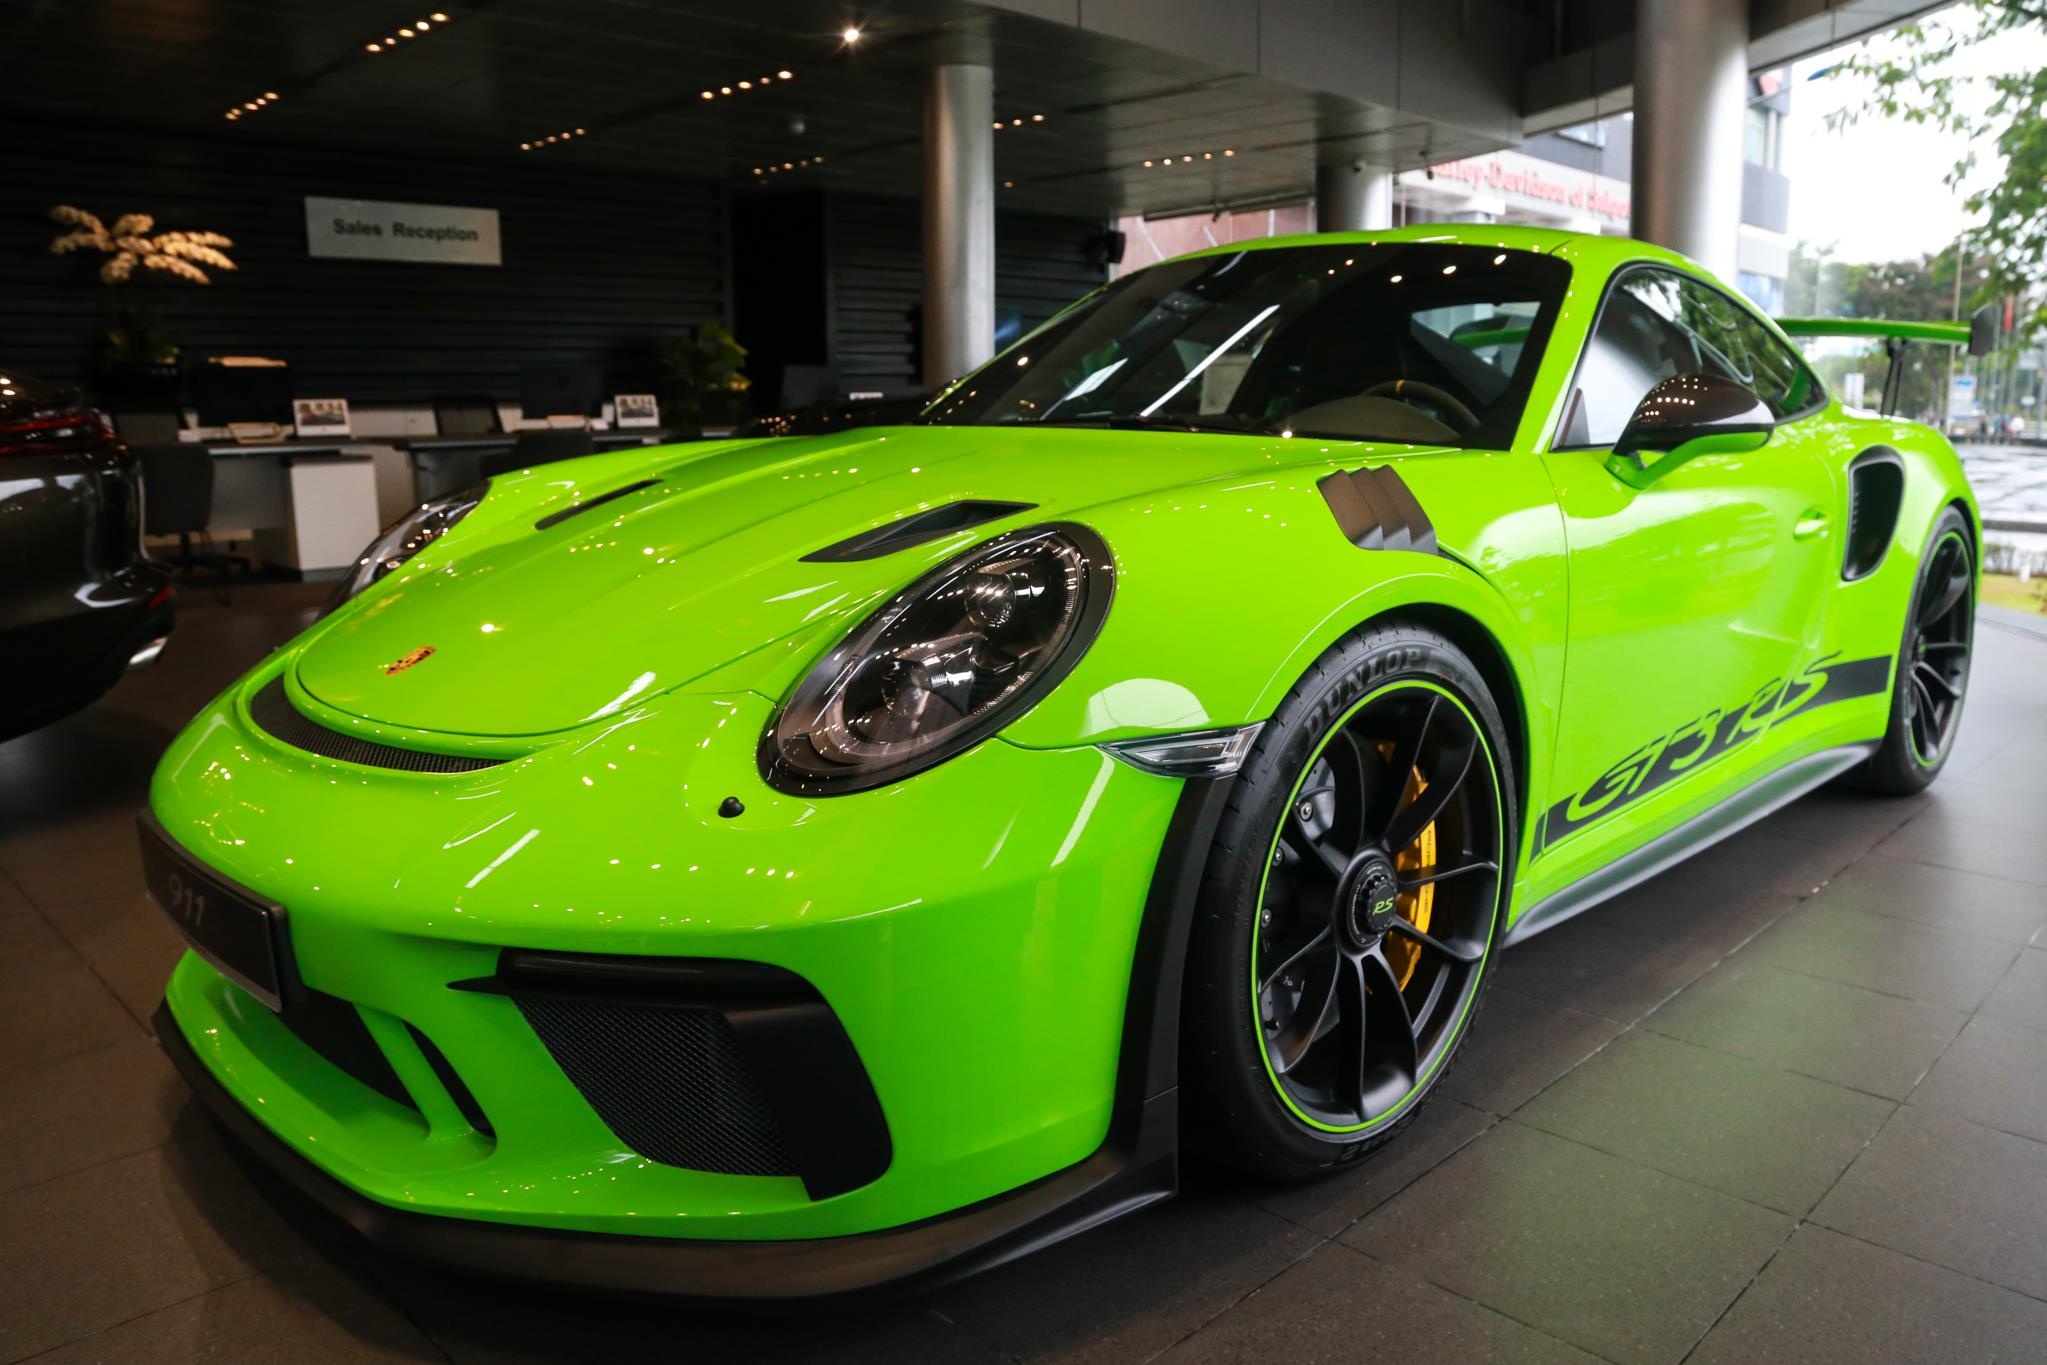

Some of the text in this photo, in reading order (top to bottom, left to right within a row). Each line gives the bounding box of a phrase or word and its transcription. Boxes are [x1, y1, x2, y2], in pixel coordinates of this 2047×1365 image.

[333, 218, 479, 242] Sales Reception
[1304, 648, 1421, 738] DUNLOP
[1566, 651, 1843, 822] GT3 RS
[169, 873, 205, 928] 911
[1372, 897, 1394, 916] RS
